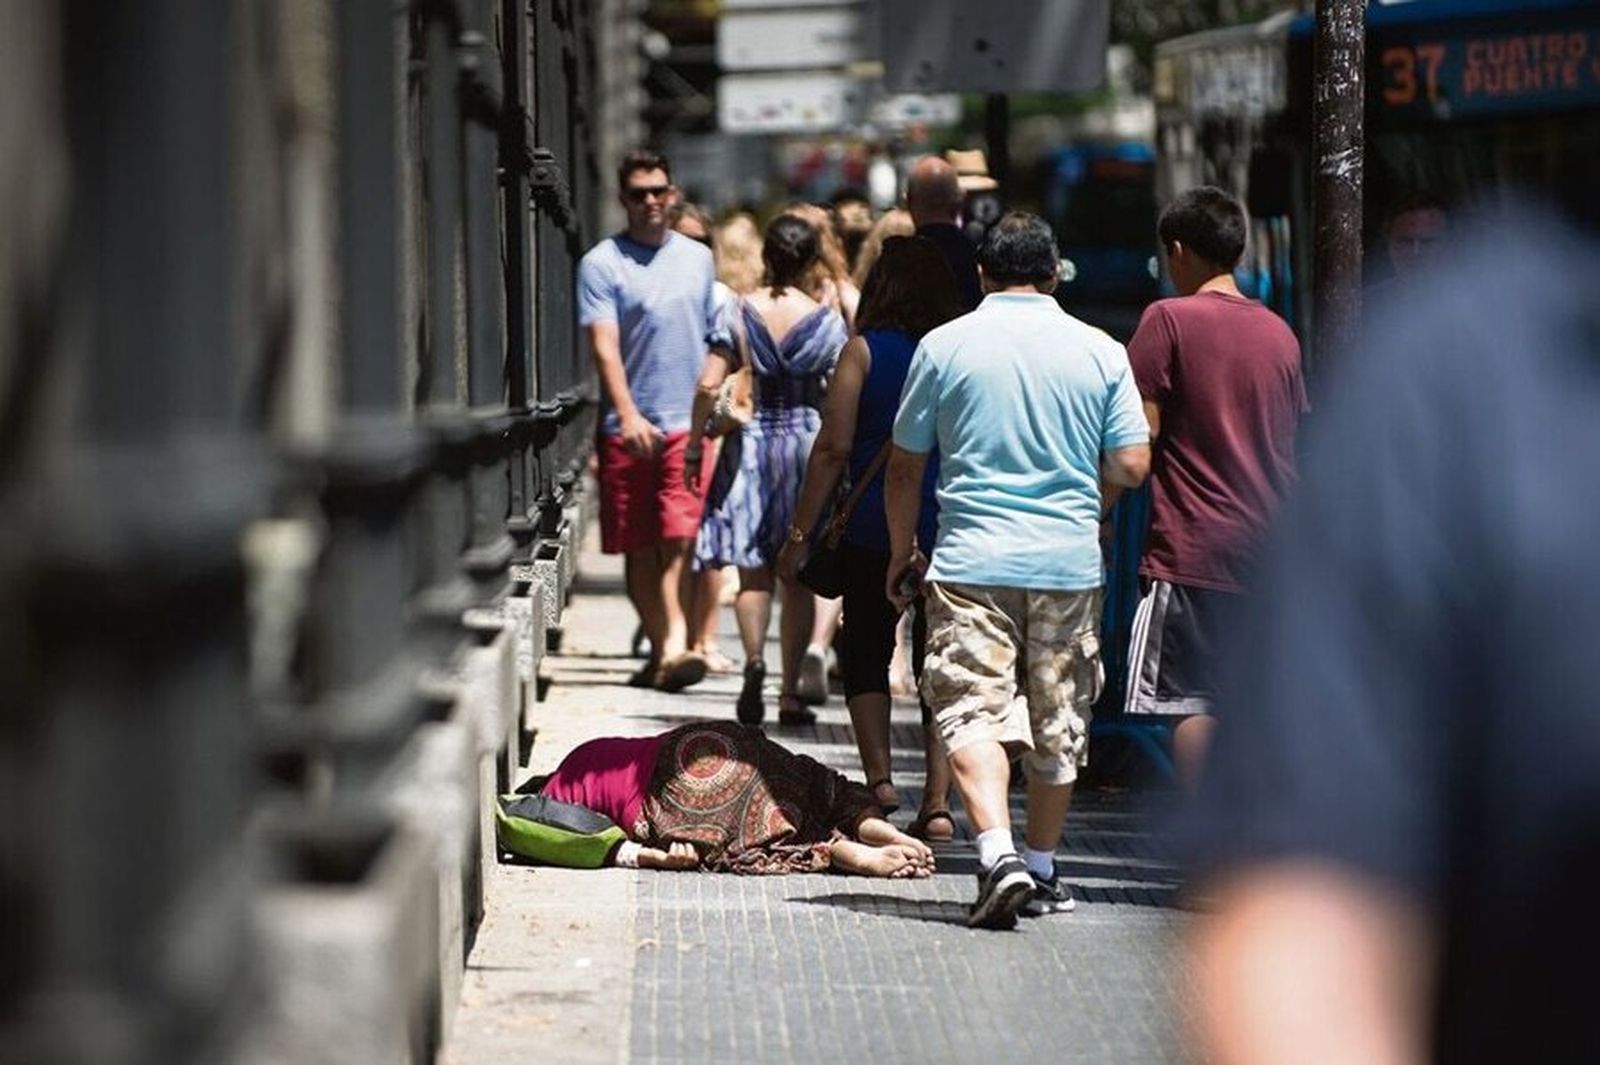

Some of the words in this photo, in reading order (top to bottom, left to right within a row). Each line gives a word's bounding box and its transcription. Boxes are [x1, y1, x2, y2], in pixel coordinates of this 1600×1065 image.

[1467, 33, 1587, 64] CUATRO
[1382, 44, 1446, 105] 37
[1464, 60, 1578, 96] PUENTE
